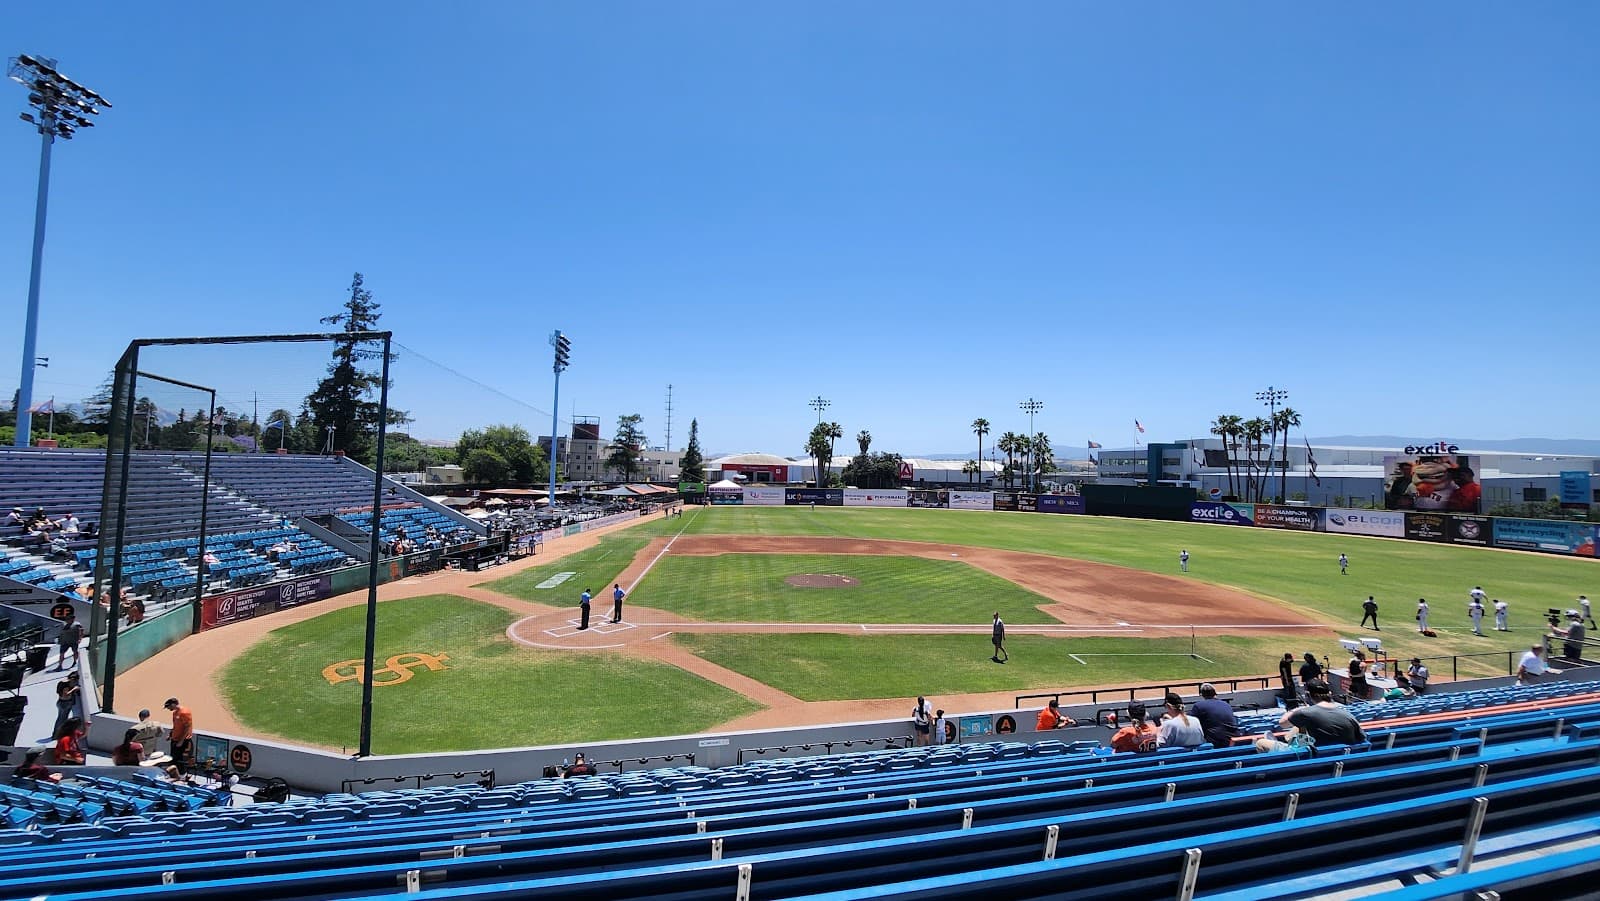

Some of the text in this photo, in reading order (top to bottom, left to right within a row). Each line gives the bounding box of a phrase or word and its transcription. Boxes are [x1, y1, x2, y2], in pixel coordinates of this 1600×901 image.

[1404, 442, 1459, 454] excite
[1192, 506, 1234, 519] excite
[1527, 528, 1565, 538] recycling
[54, 608, 71, 618] EF
[1001, 719, 1011, 729] A
[233, 749, 250, 762] CB
